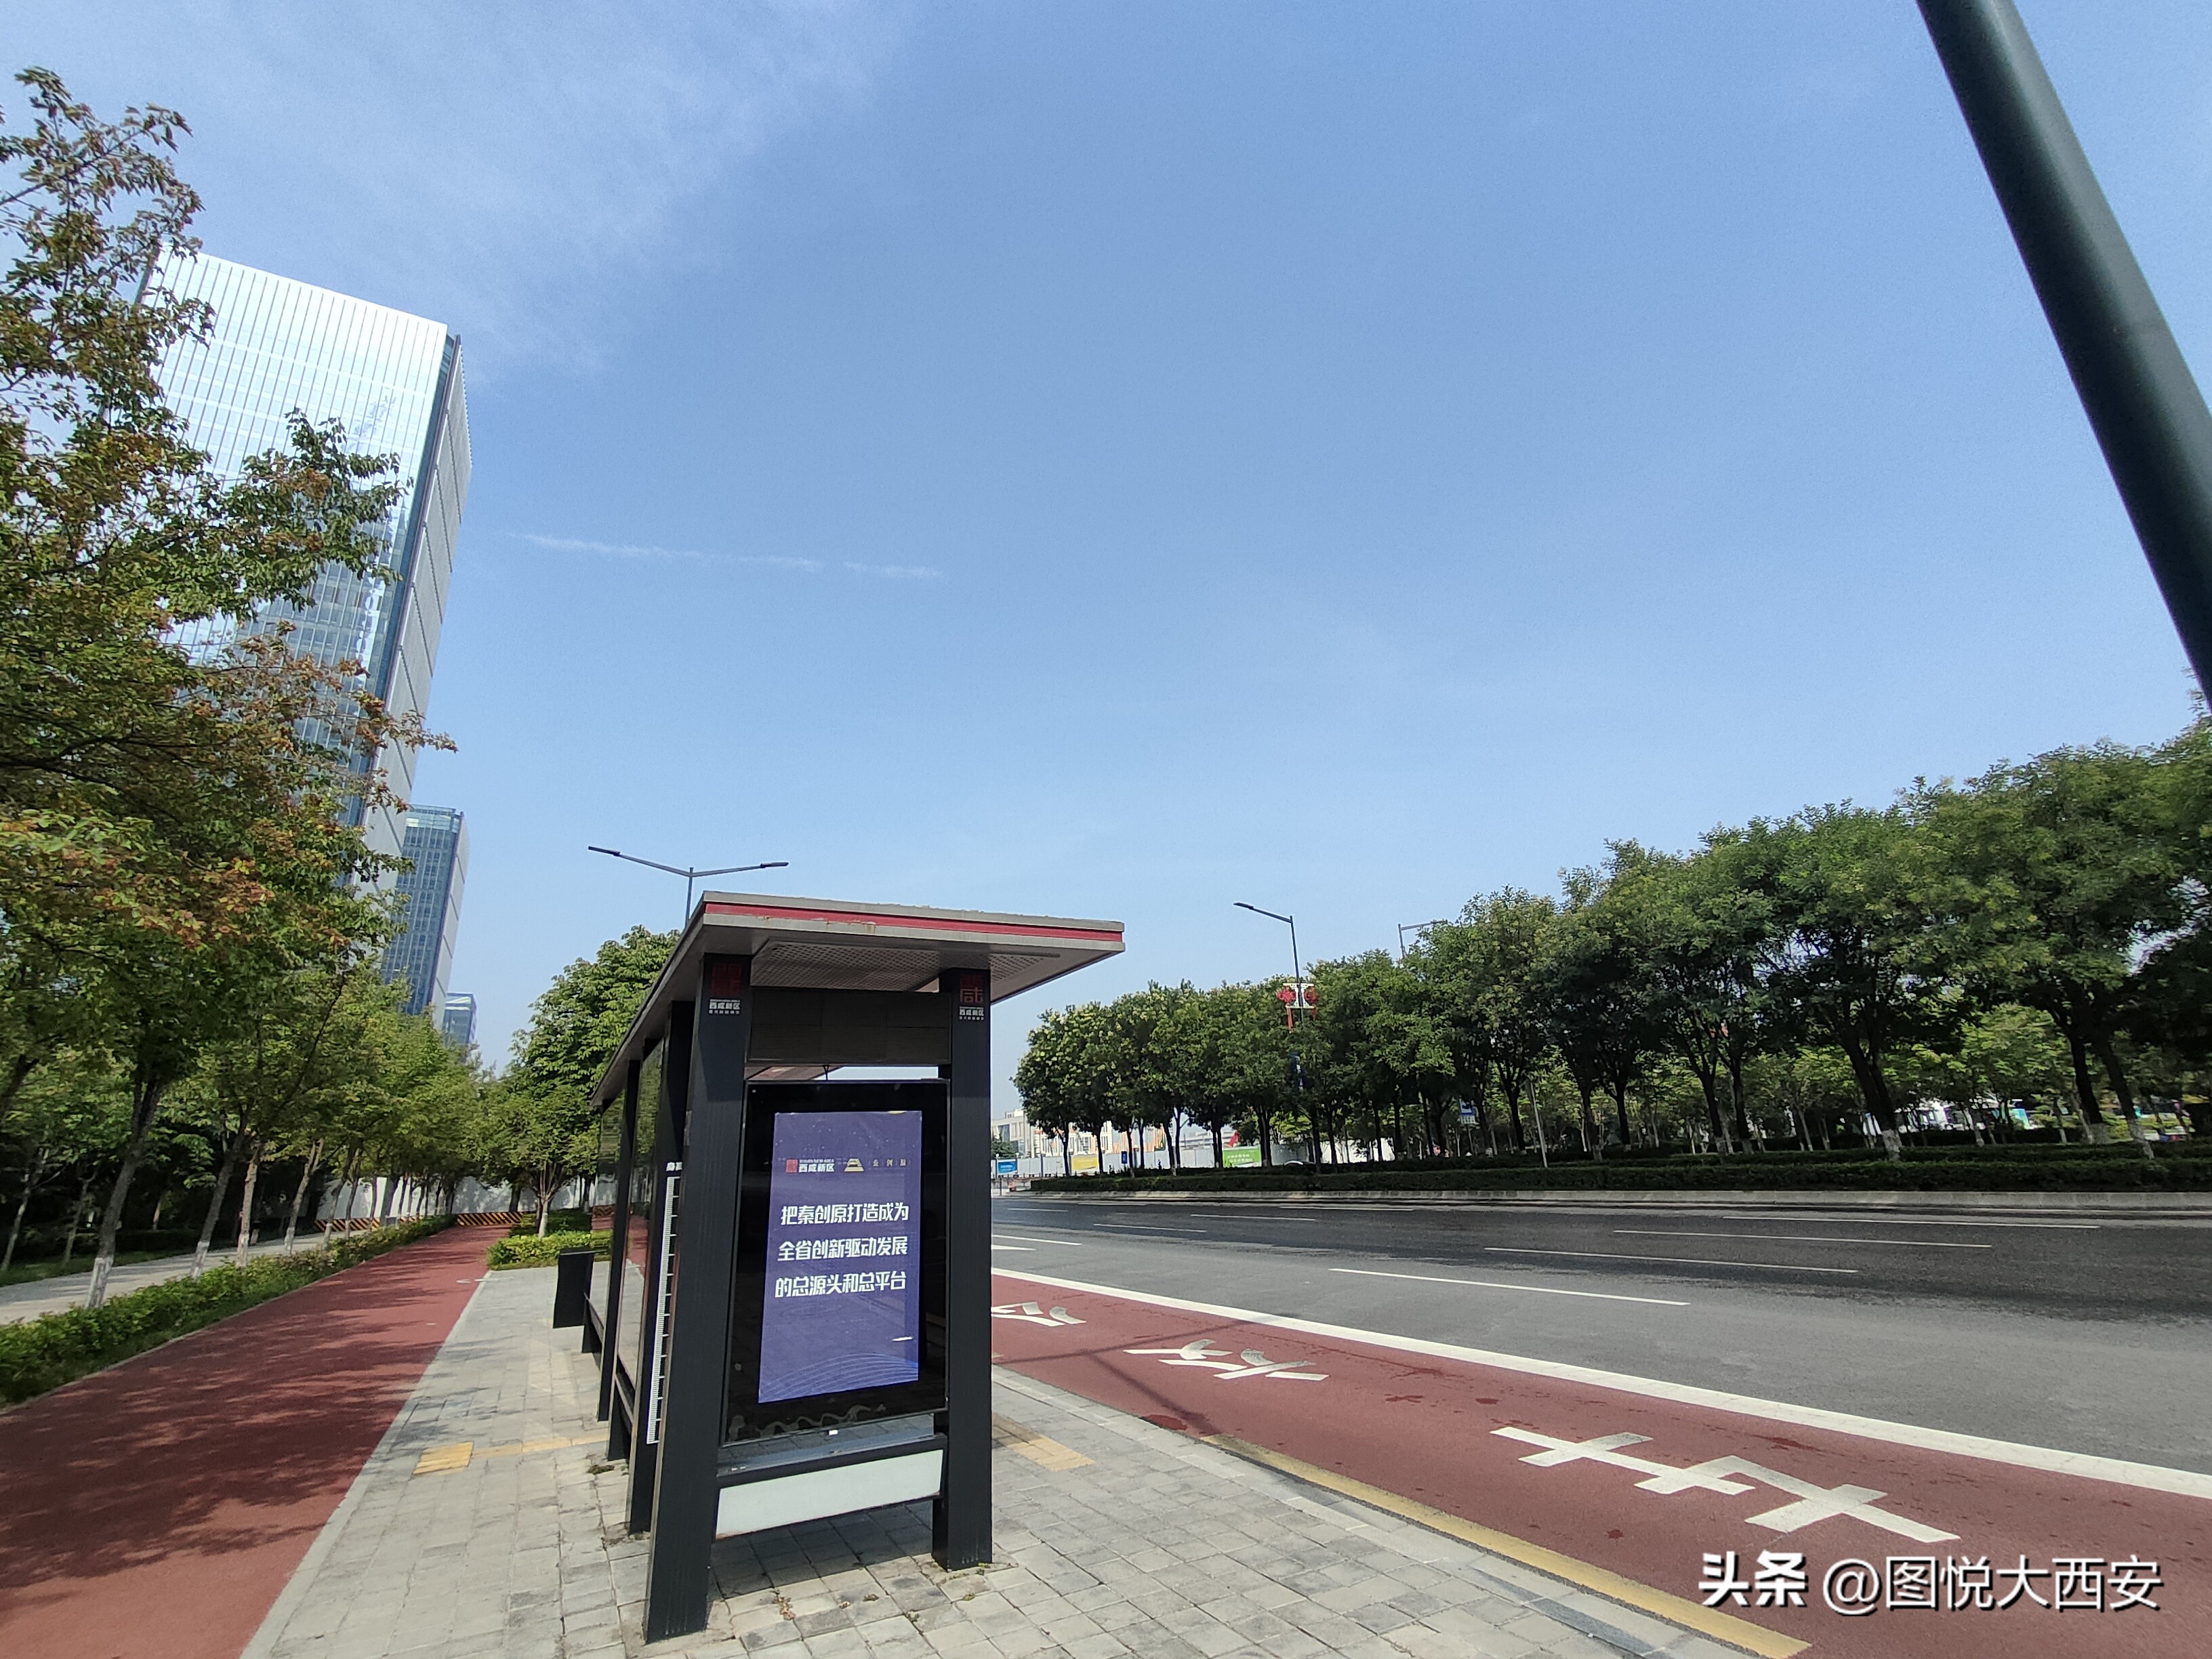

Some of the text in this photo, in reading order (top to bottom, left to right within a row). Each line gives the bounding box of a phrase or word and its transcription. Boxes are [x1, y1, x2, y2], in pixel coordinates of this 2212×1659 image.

[798, 1163, 835, 1172] 西咸新区
[780, 1202, 909, 1226] 把秦创原打造成为
[777, 1235, 908, 1261] 全省创新驱动发展
[775, 1270, 907, 1298] 的总源头和总平台
